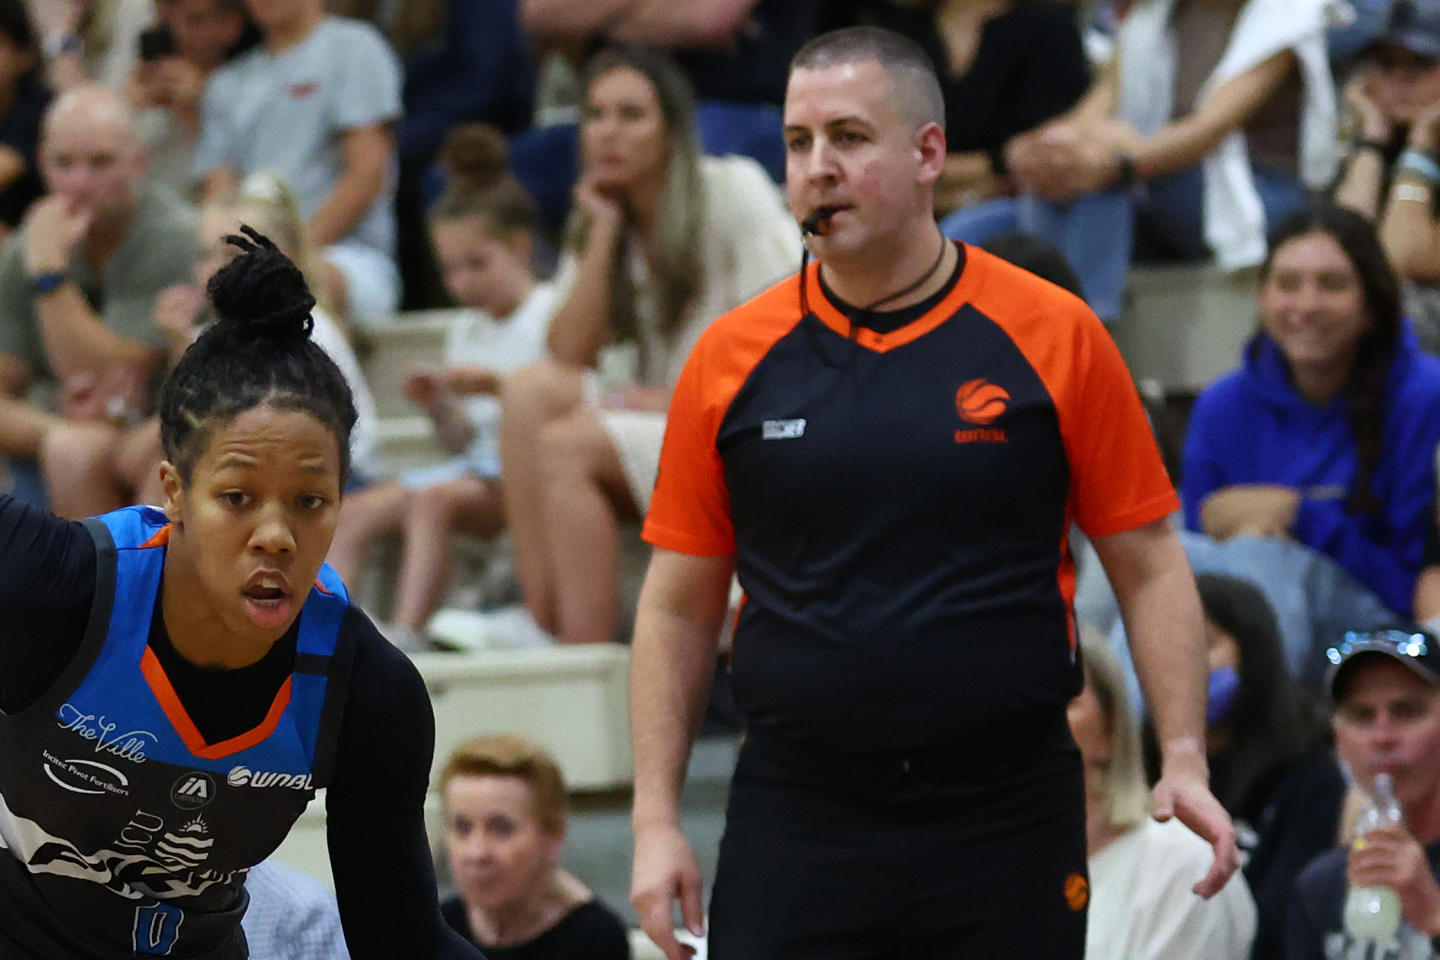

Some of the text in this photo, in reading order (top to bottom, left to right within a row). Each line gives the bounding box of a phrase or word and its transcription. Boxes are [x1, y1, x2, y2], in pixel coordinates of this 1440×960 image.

[58, 704, 158, 763] The Ville
[43, 750, 68, 770] Incitec
[68, 765, 89, 780] Pivot
